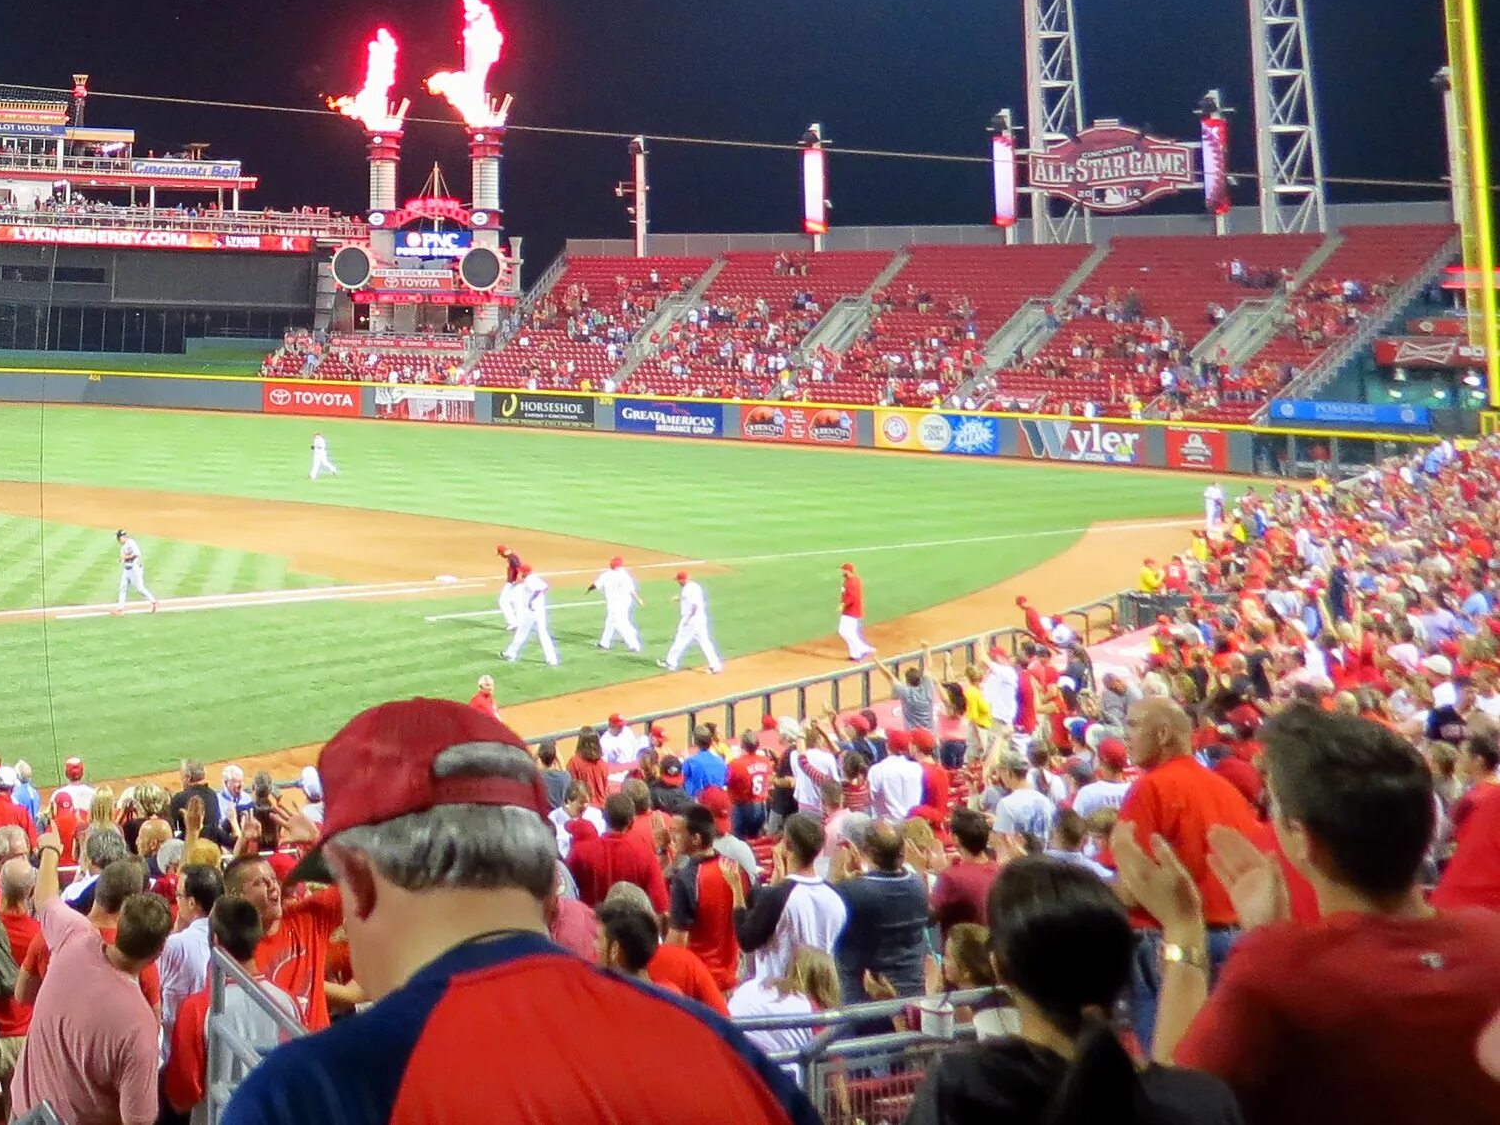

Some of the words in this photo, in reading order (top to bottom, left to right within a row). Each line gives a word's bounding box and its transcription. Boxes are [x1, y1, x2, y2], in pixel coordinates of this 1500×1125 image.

[18, 124, 51, 132] HOUSE
[1081, 146, 1135, 159] CINCINNATI
[133, 162, 206, 176] Cincinnati
[211, 165, 239, 178] Bell
[1128, 151, 1187, 176] GAME
[14, 227, 187, 246] LYKINSENERGY.COM
[226, 235, 260, 246] LYKINS
[422, 233, 459, 248] PNC
[282, 237, 294, 250] K
[401, 278, 440, 288] TOYOTA
[293, 391, 354, 407] TOYOTA
[520, 401, 582, 414] HORSESHOE
[622, 407, 662, 422] GREAT
[657, 411, 716, 427] AMERICAN
[655, 425, 692, 434] INSURANCE
[746, 424, 768, 434] QUEEN
[769, 425, 784, 434] CITY
[810, 427, 833, 437] QUEEN
[834, 428, 850, 438] CITY
[1019, 419, 1140, 460] Wyler
[752, 774, 763, 795] 6
